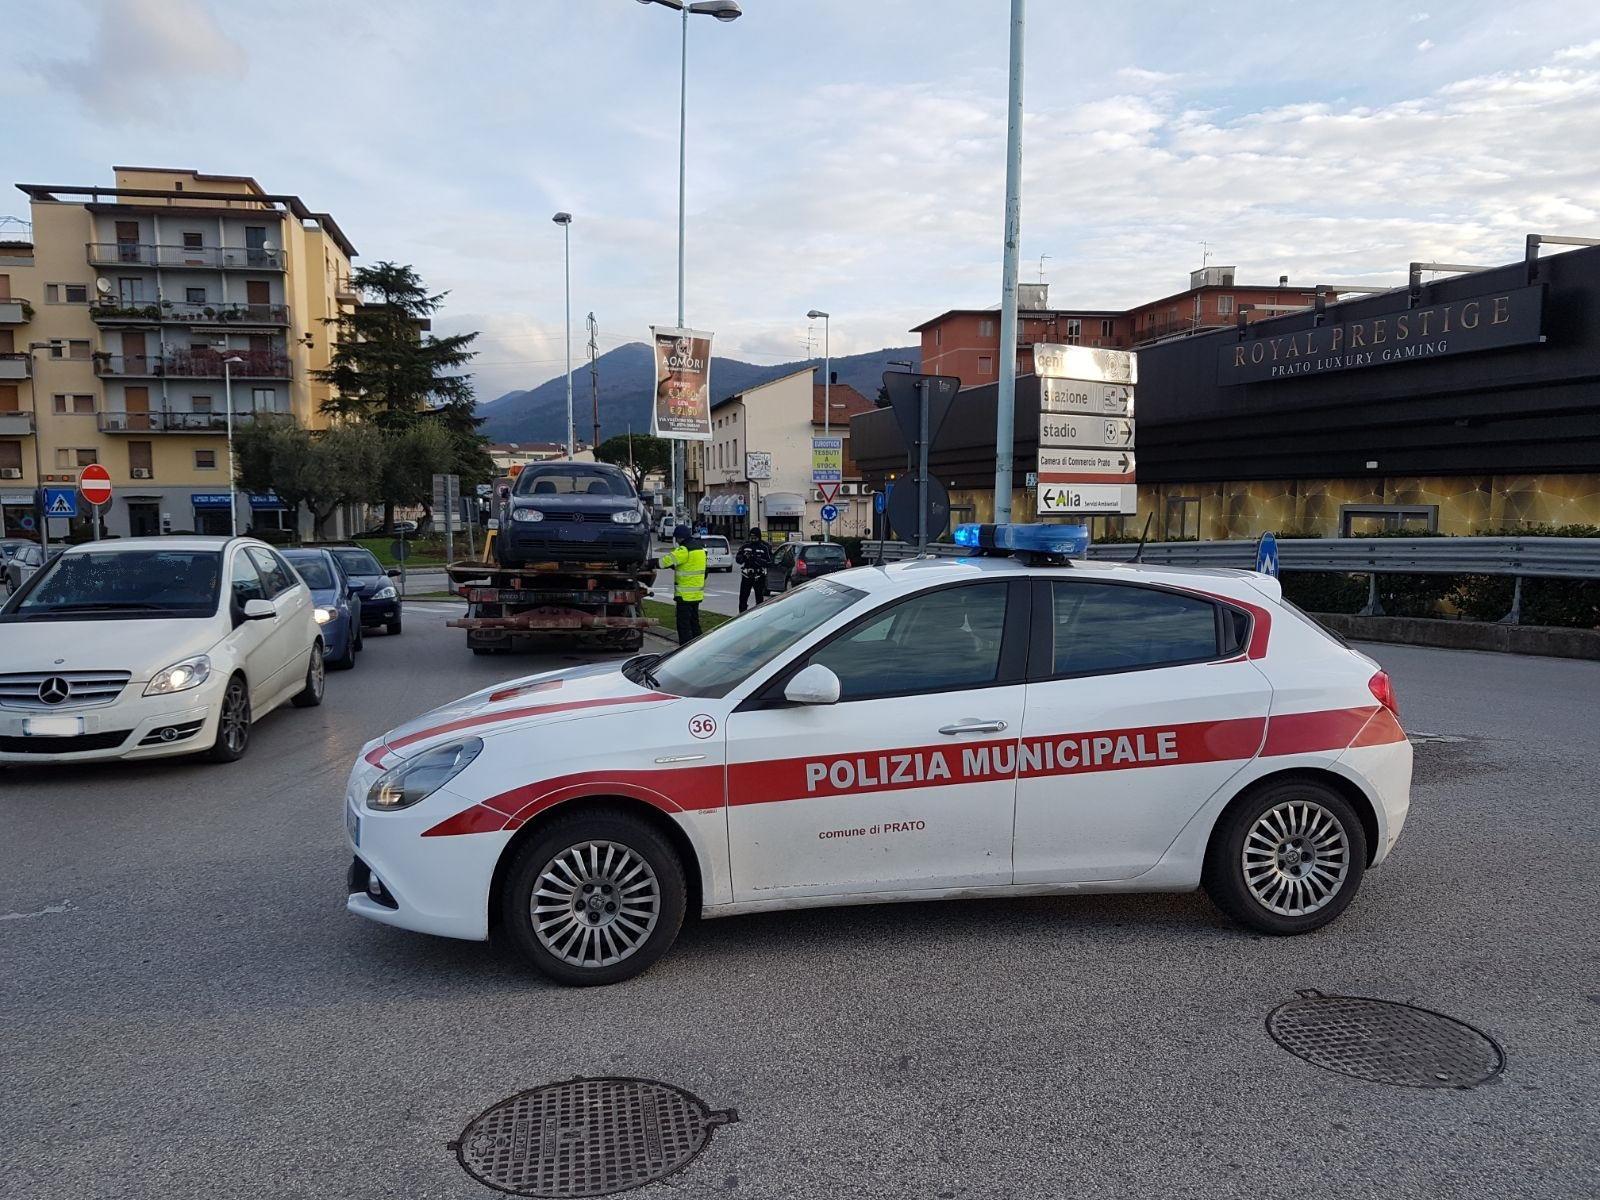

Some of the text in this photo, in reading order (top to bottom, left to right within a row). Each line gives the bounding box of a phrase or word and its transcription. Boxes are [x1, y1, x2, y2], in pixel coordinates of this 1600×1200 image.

[1233, 296, 1511, 367] ROYAL PRESTIGE
[663, 356, 704, 369] AOMORI
[1271, 340, 1448, 377] PRATO LUXURY GAMING
[1043, 423, 1077, 438] stadio
[1040, 456, 1111, 467] Camera di Commercio Prato
[1056, 489, 1081, 507] Alia
[691, 719, 713, 733] 36
[805, 731, 1179, 792] POLIZIA MUNICIPALE
[818, 820, 925, 840] comune di PRATO
